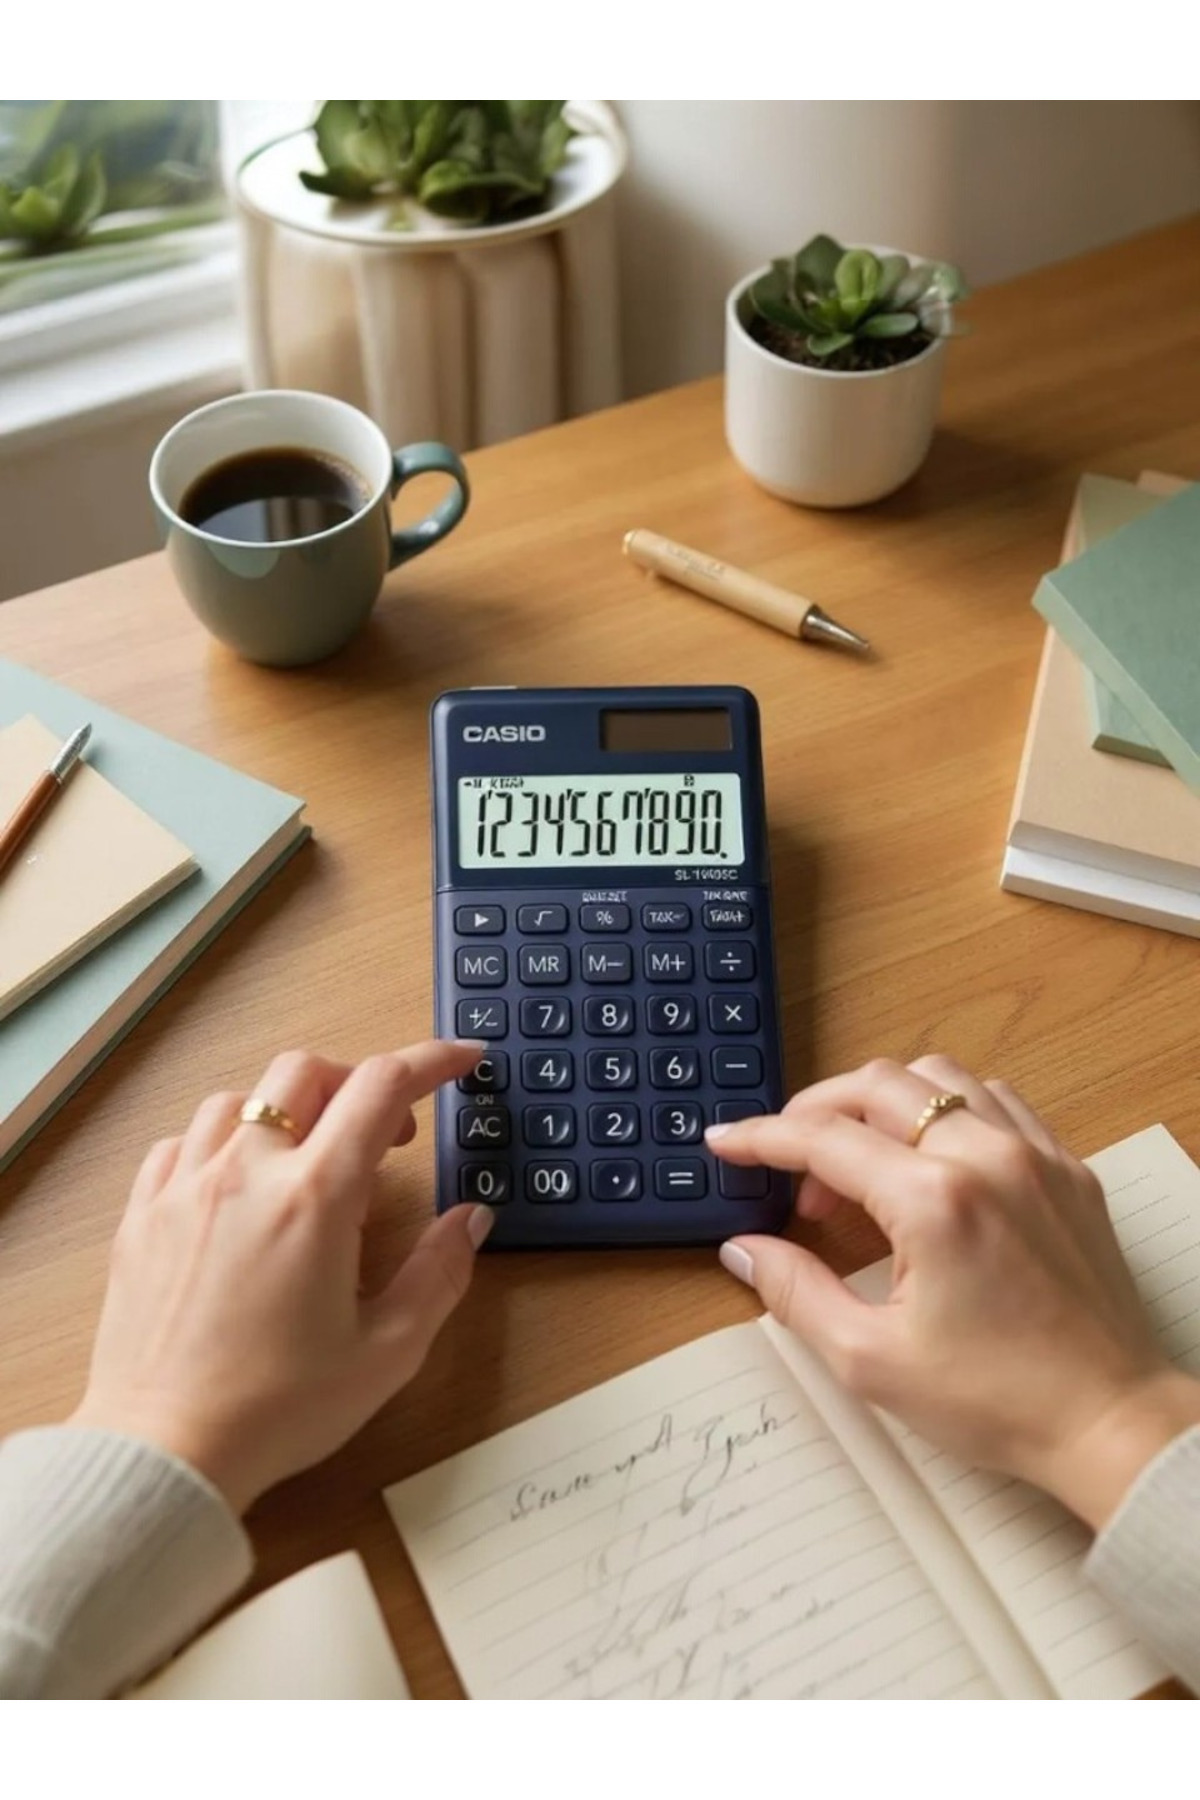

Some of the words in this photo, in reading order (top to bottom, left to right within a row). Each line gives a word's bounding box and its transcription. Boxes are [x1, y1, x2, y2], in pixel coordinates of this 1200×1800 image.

[463, 725, 546, 743] CASIO
[464, 957, 499, 974] MC
[529, 956, 559, 973] MR
[652, 954, 685, 972] M+
[539, 1006, 553, 1028] 7
[601, 1004, 617, 1027] 8
[664, 1003, 679, 1025] 9
[475, 1060, 492, 1080] C
[539, 1059, 555, 1081] 4
[605, 1057, 620, 1079] 5
[667, 1056, 682, 1079] 6
[468, 1118, 500, 1138] AC
[542, 1115, 554, 1136] 1
[607, 1114, 622, 1136] 2
[671, 1113, 685, 1134] 3
[478, 1171, 493, 1195] 0
[534, 1169, 567, 1194] 00
